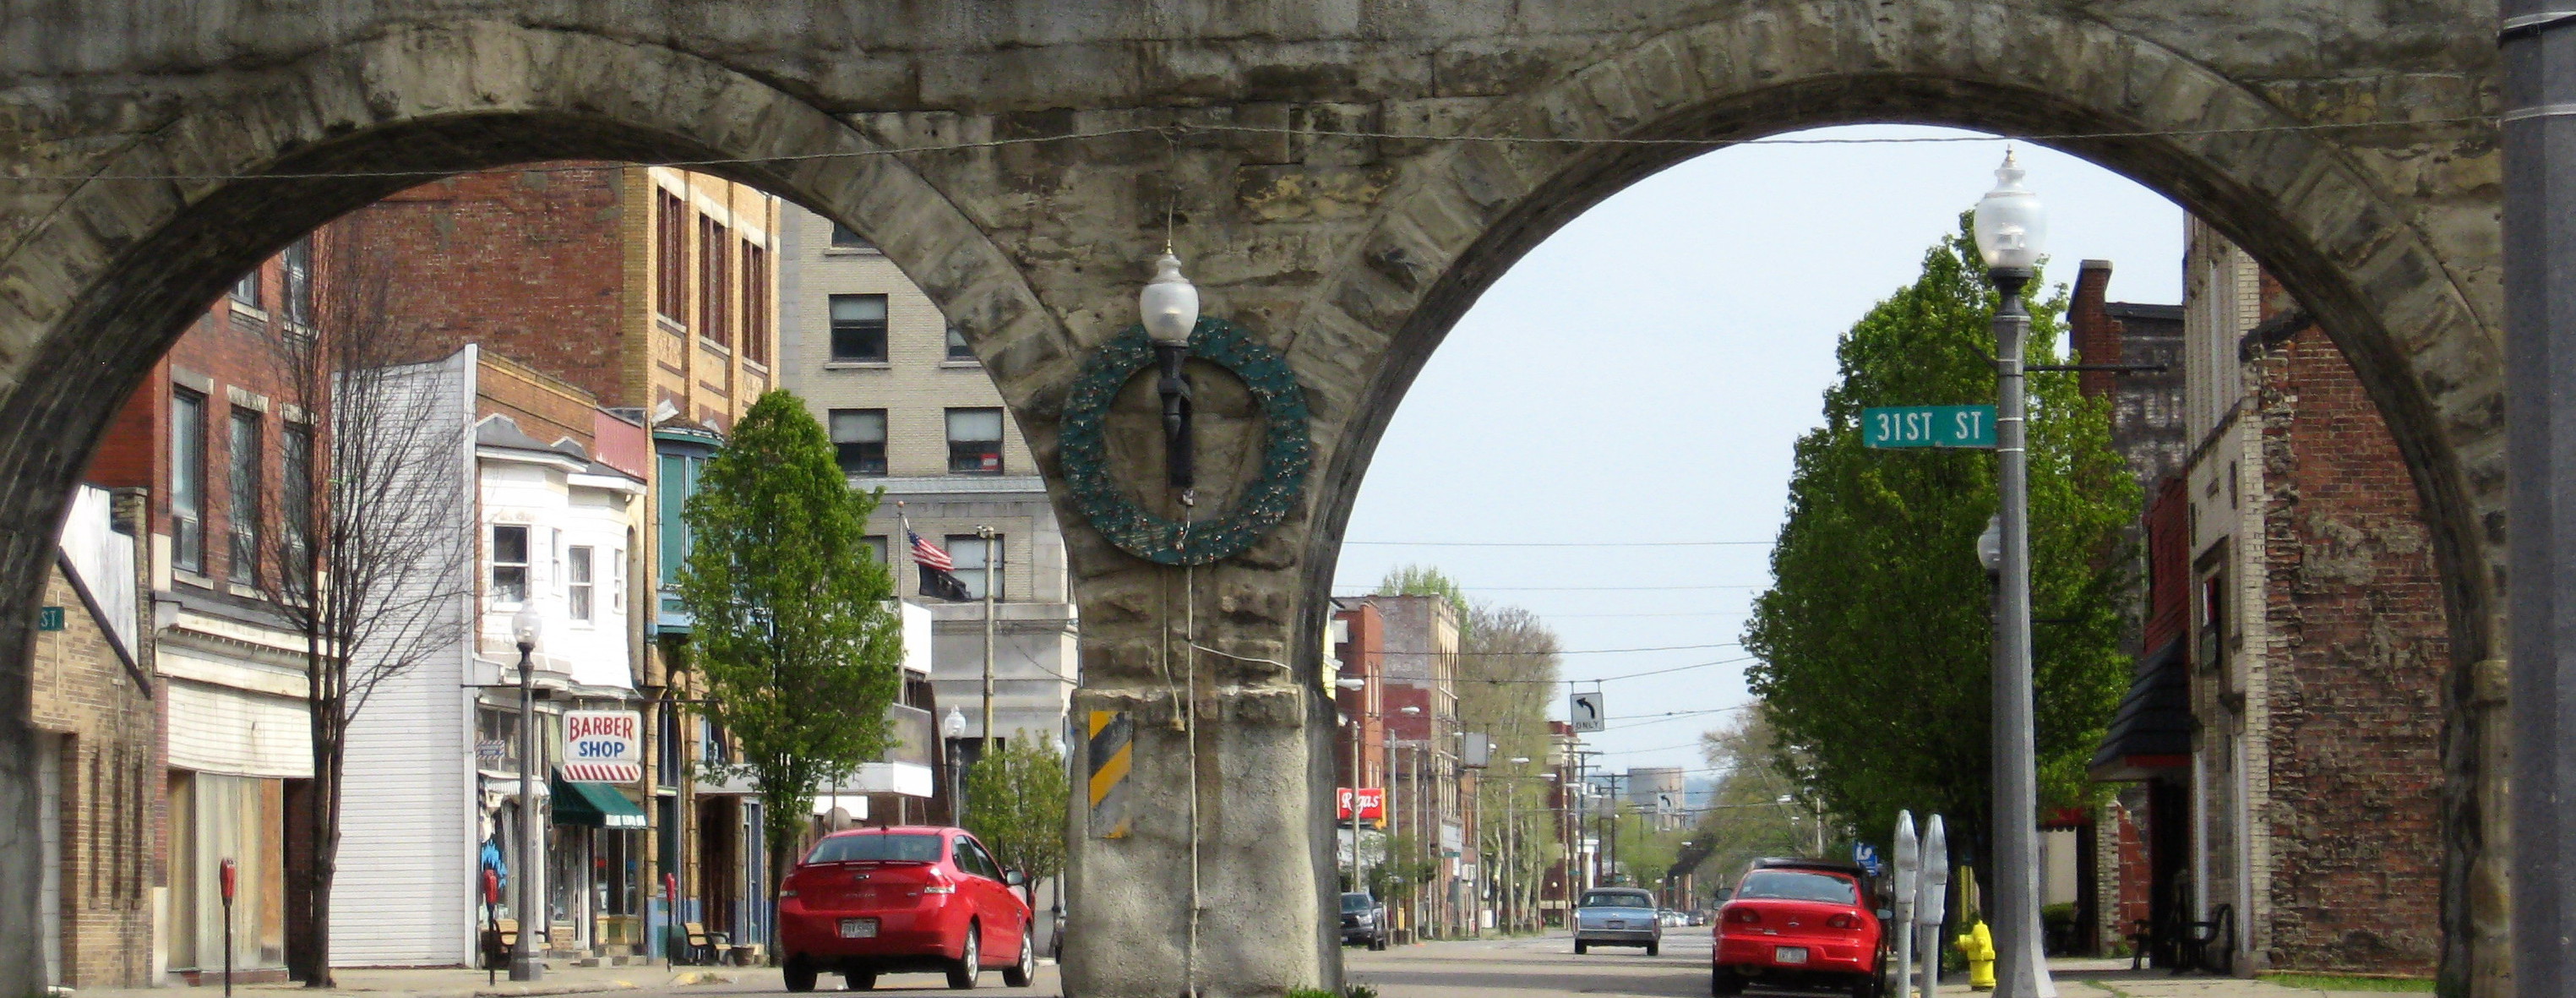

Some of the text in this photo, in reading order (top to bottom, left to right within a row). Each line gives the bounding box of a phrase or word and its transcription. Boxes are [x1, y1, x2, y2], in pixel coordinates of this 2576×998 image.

[1876, 411, 1982, 441] 31ST ST
[40, 610, 57, 628] ST
[569, 717, 634, 743] BARBER
[1576, 720, 1599, 729] ONLY
[579, 741, 625, 758] SHOP
